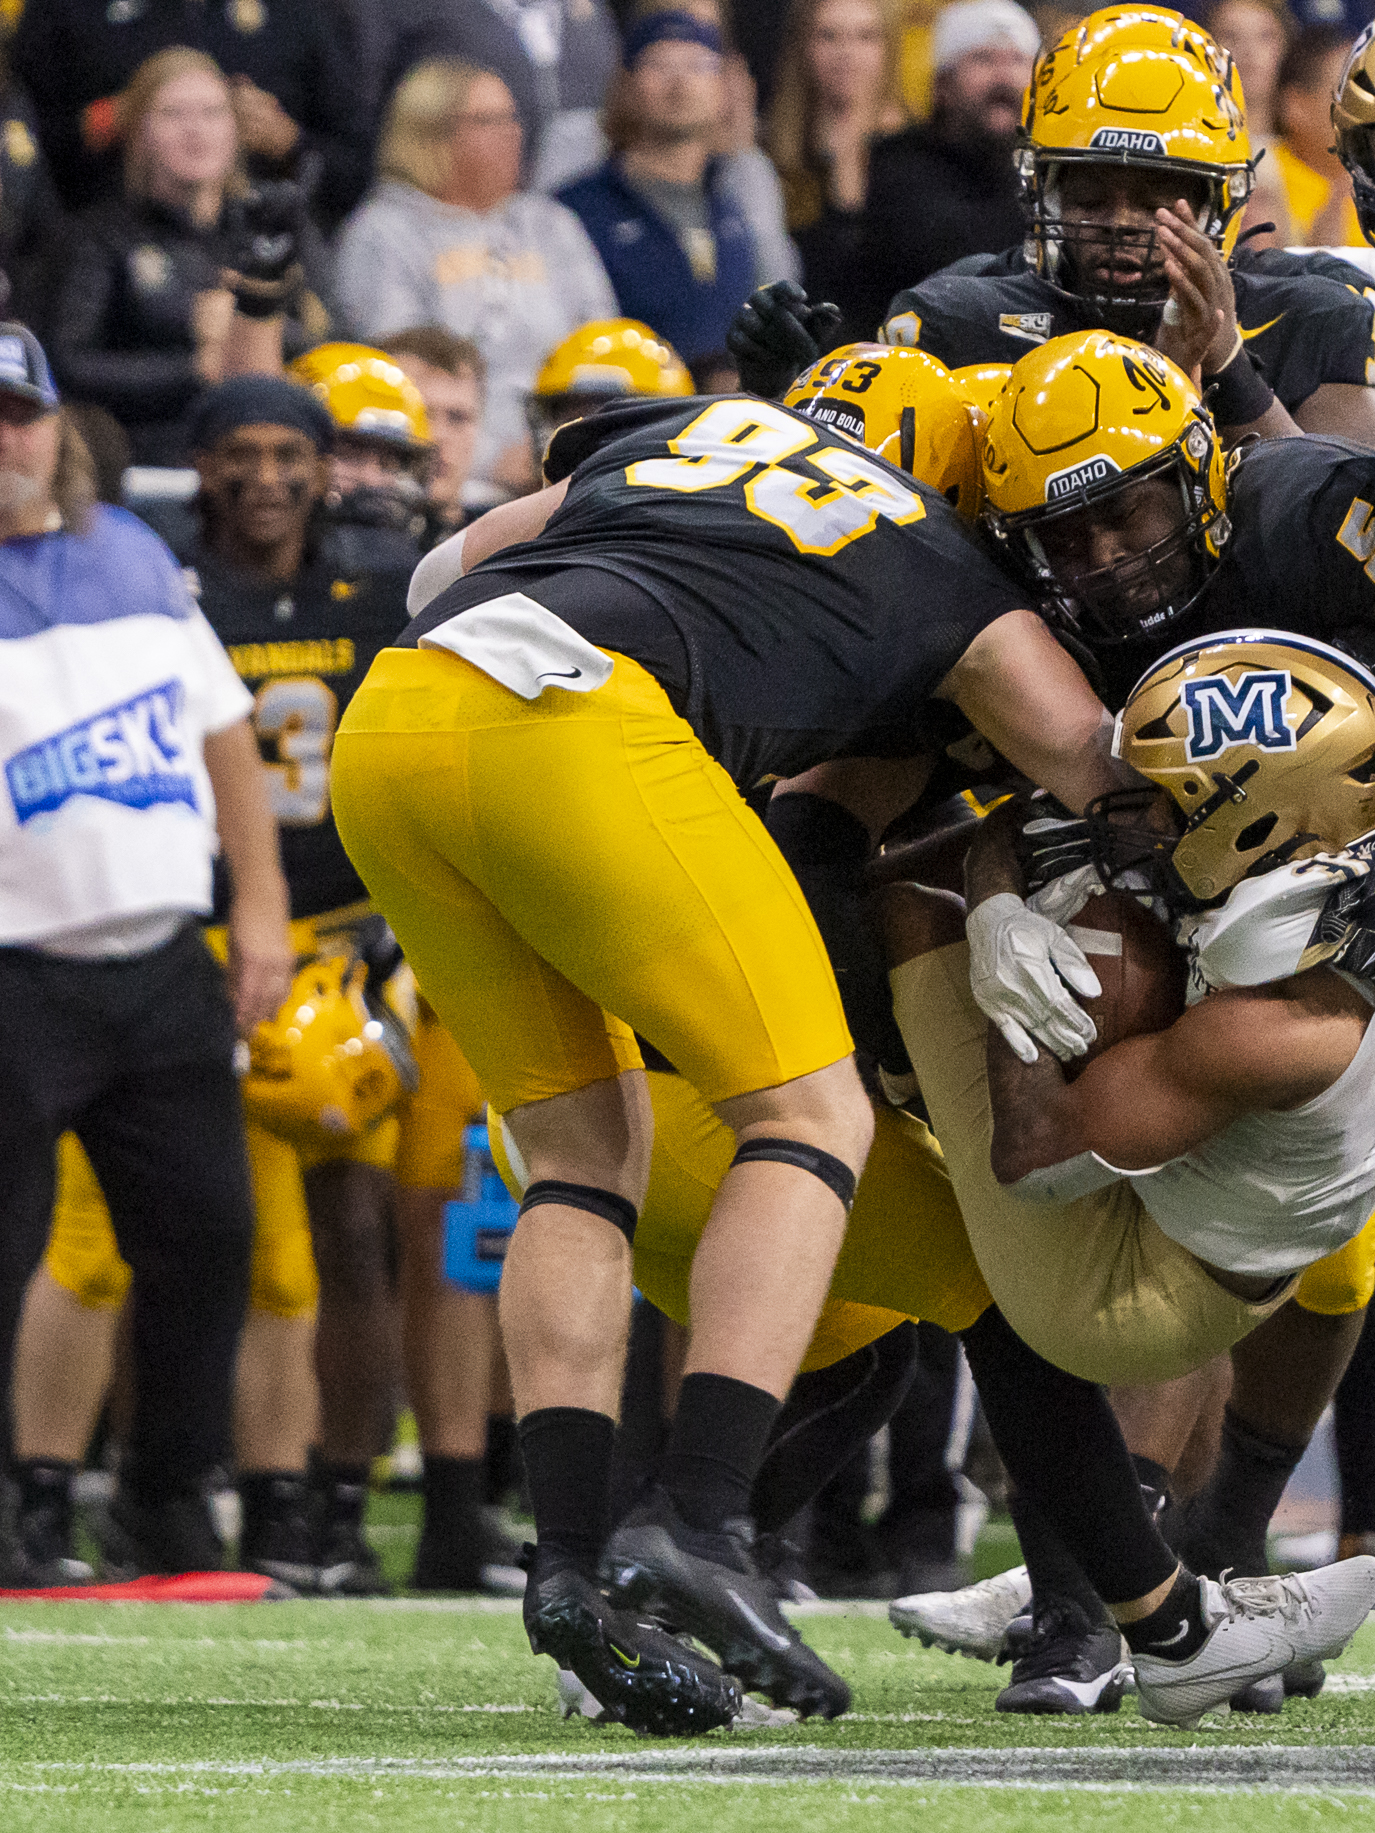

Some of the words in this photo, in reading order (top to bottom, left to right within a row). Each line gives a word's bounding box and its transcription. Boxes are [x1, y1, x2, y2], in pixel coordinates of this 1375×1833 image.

[1099, 131, 1158, 150] IDAHO
[812, 358, 882, 394] 93
[814, 408, 837, 423] AND
[836, 412, 865, 435] BOLD
[624, 398, 926, 556] 93
[1051, 461, 1107, 497] IDAHO
[1181, 670, 1297, 763] M
